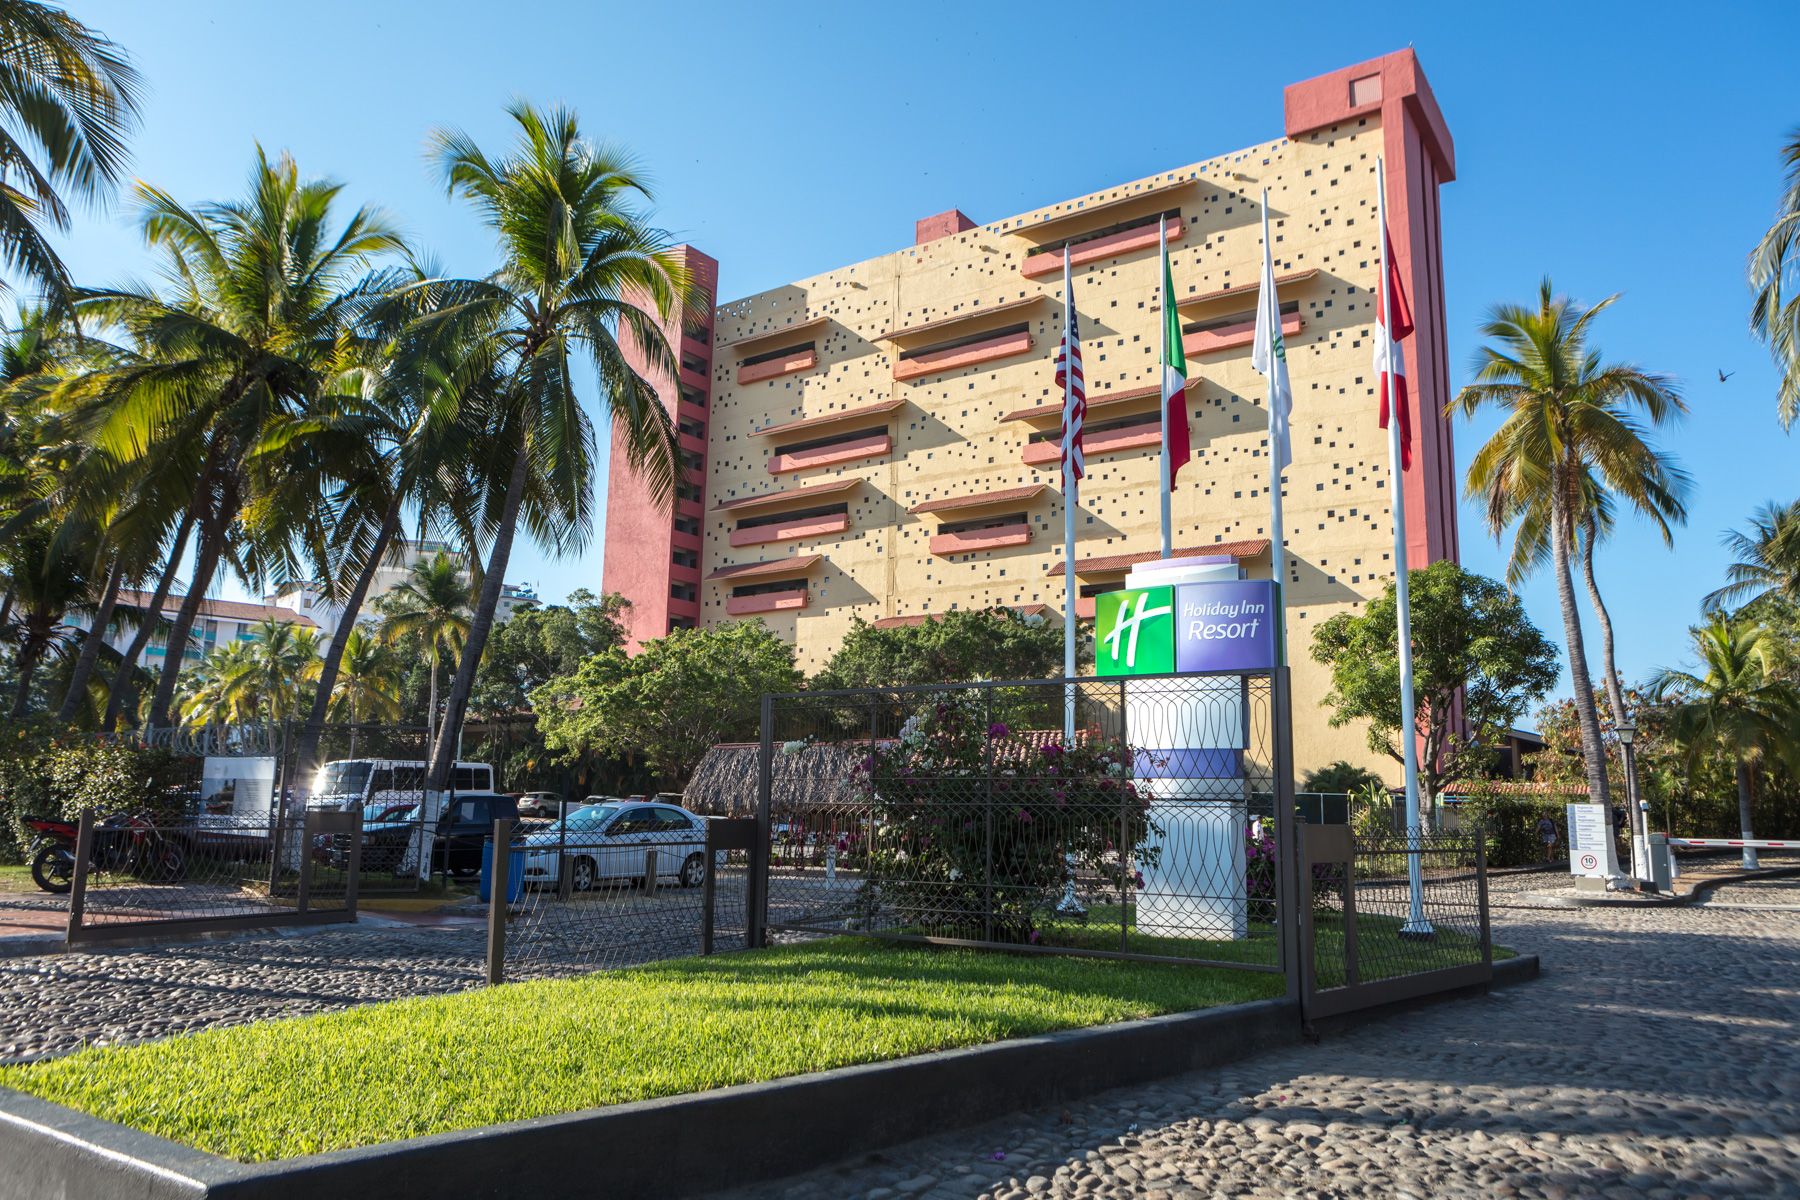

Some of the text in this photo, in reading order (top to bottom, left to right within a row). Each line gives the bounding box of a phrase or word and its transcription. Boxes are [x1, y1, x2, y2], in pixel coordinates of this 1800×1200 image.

[1184, 600, 1264, 618] Holiday Inn
[1188, 619, 1260, 640] Resort
